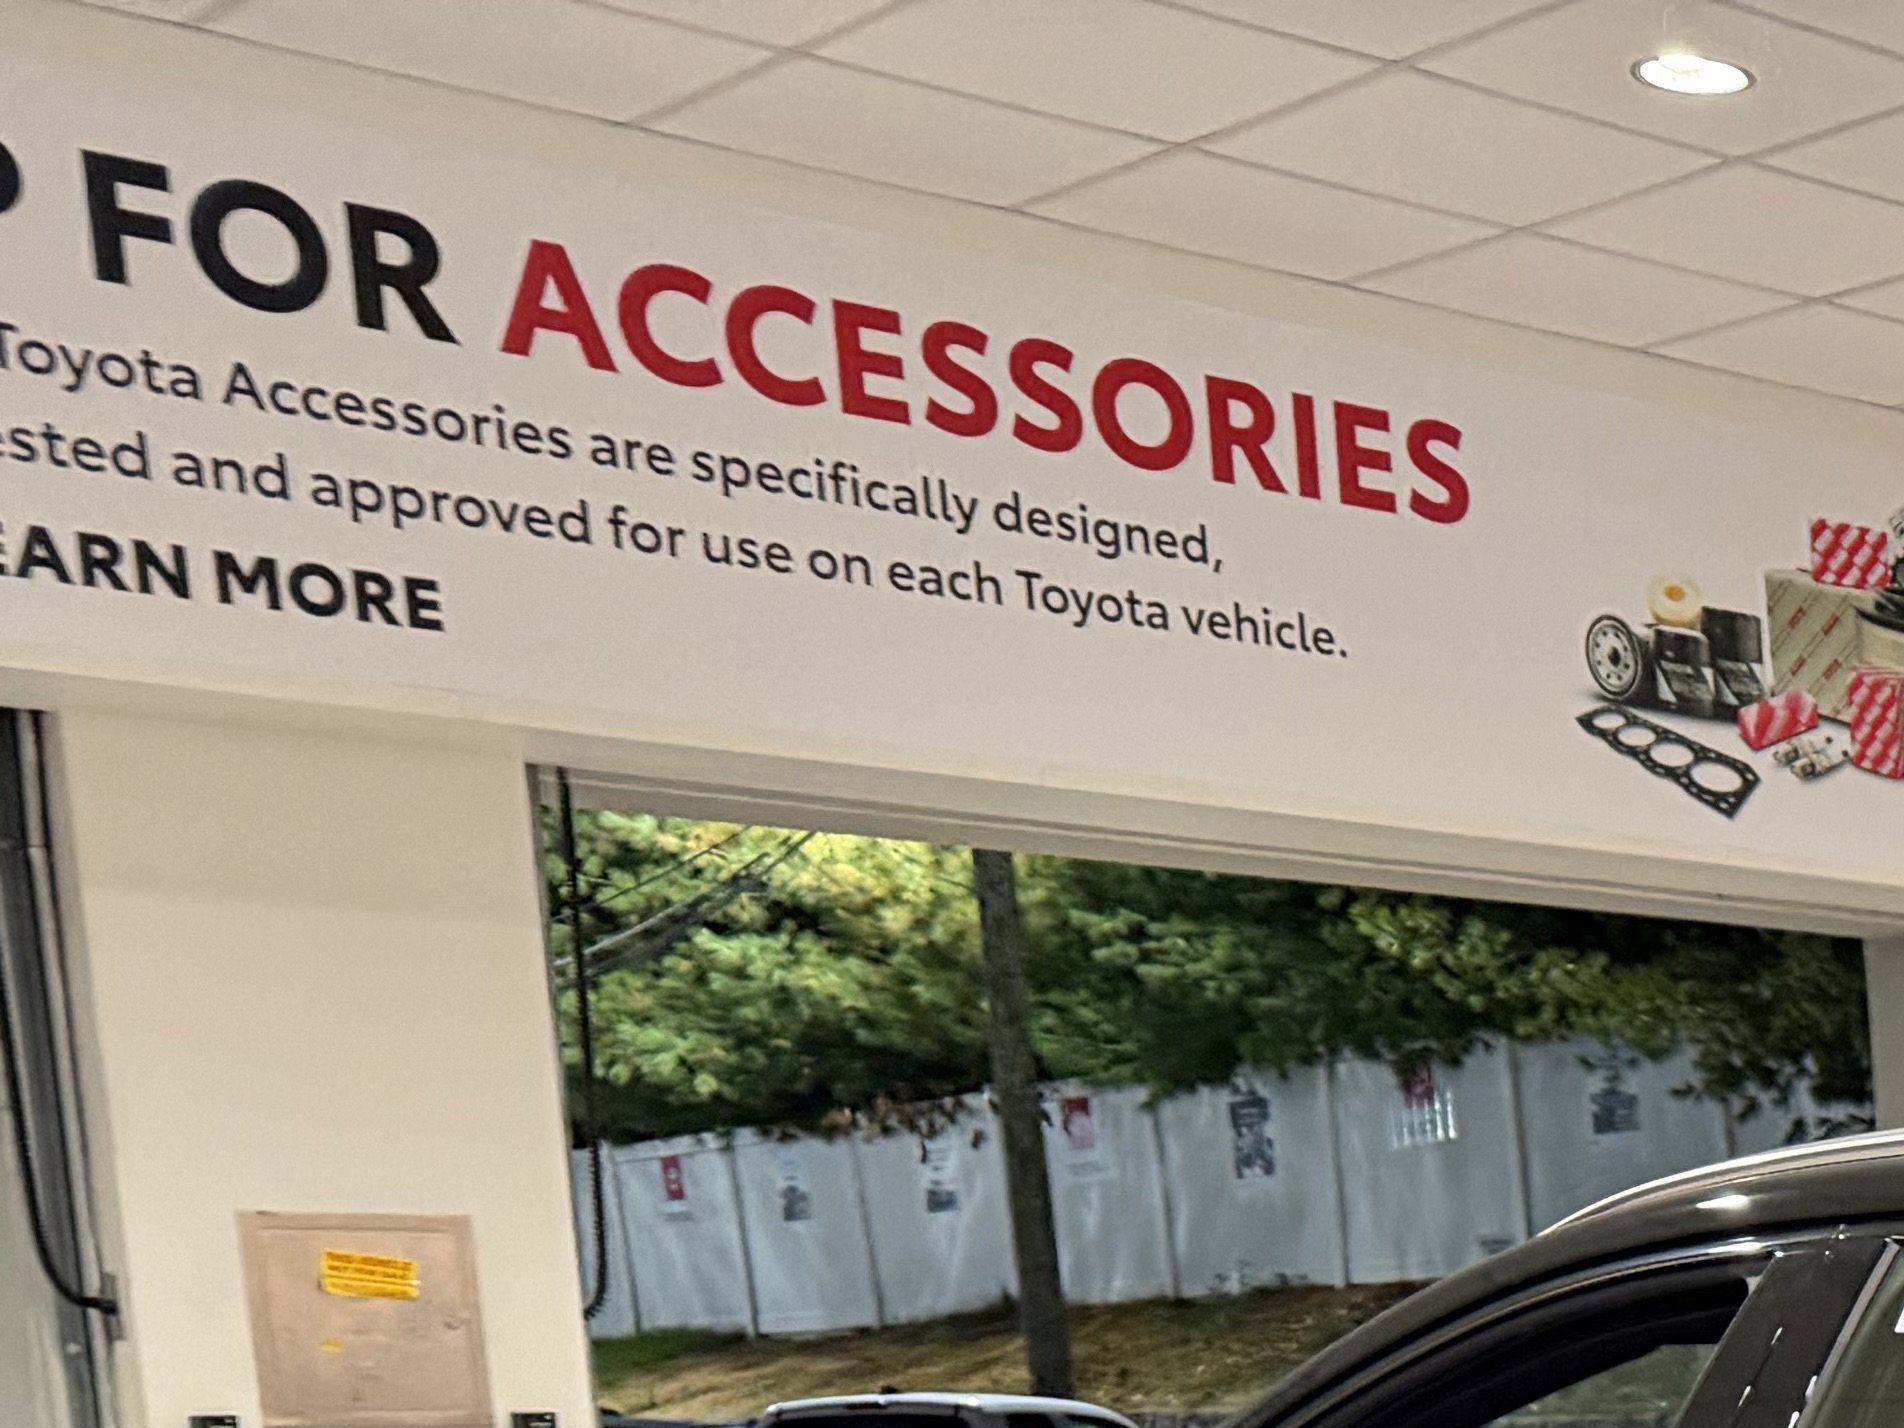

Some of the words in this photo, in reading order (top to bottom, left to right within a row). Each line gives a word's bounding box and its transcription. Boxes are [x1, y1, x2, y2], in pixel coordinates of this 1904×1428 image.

[0, 322, 204, 401] Toyota
[222, 362, 574, 462] Accessories
[589, 432, 677, 478] are
[692, 440, 979, 536] specifically
[993, 491, 1226, 574] designed,
[79, 147, 462, 345] FOR
[499, 238, 1470, 525] ACCESSORIES
[0, 423, 152, 481] sted
[172, 443, 292, 505] and
[310, 464, 593, 546] approved
[607, 505, 686, 560] for
[702, 530, 793, 575] use
[808, 545, 873, 588] on
[888, 555, 1004, 607] each
[1015, 569, 1171, 631] Toyota
[1181, 603, 1349, 660] vehicle.
[0, 521, 192, 600] ARN
[213, 548, 446, 634] MORE
